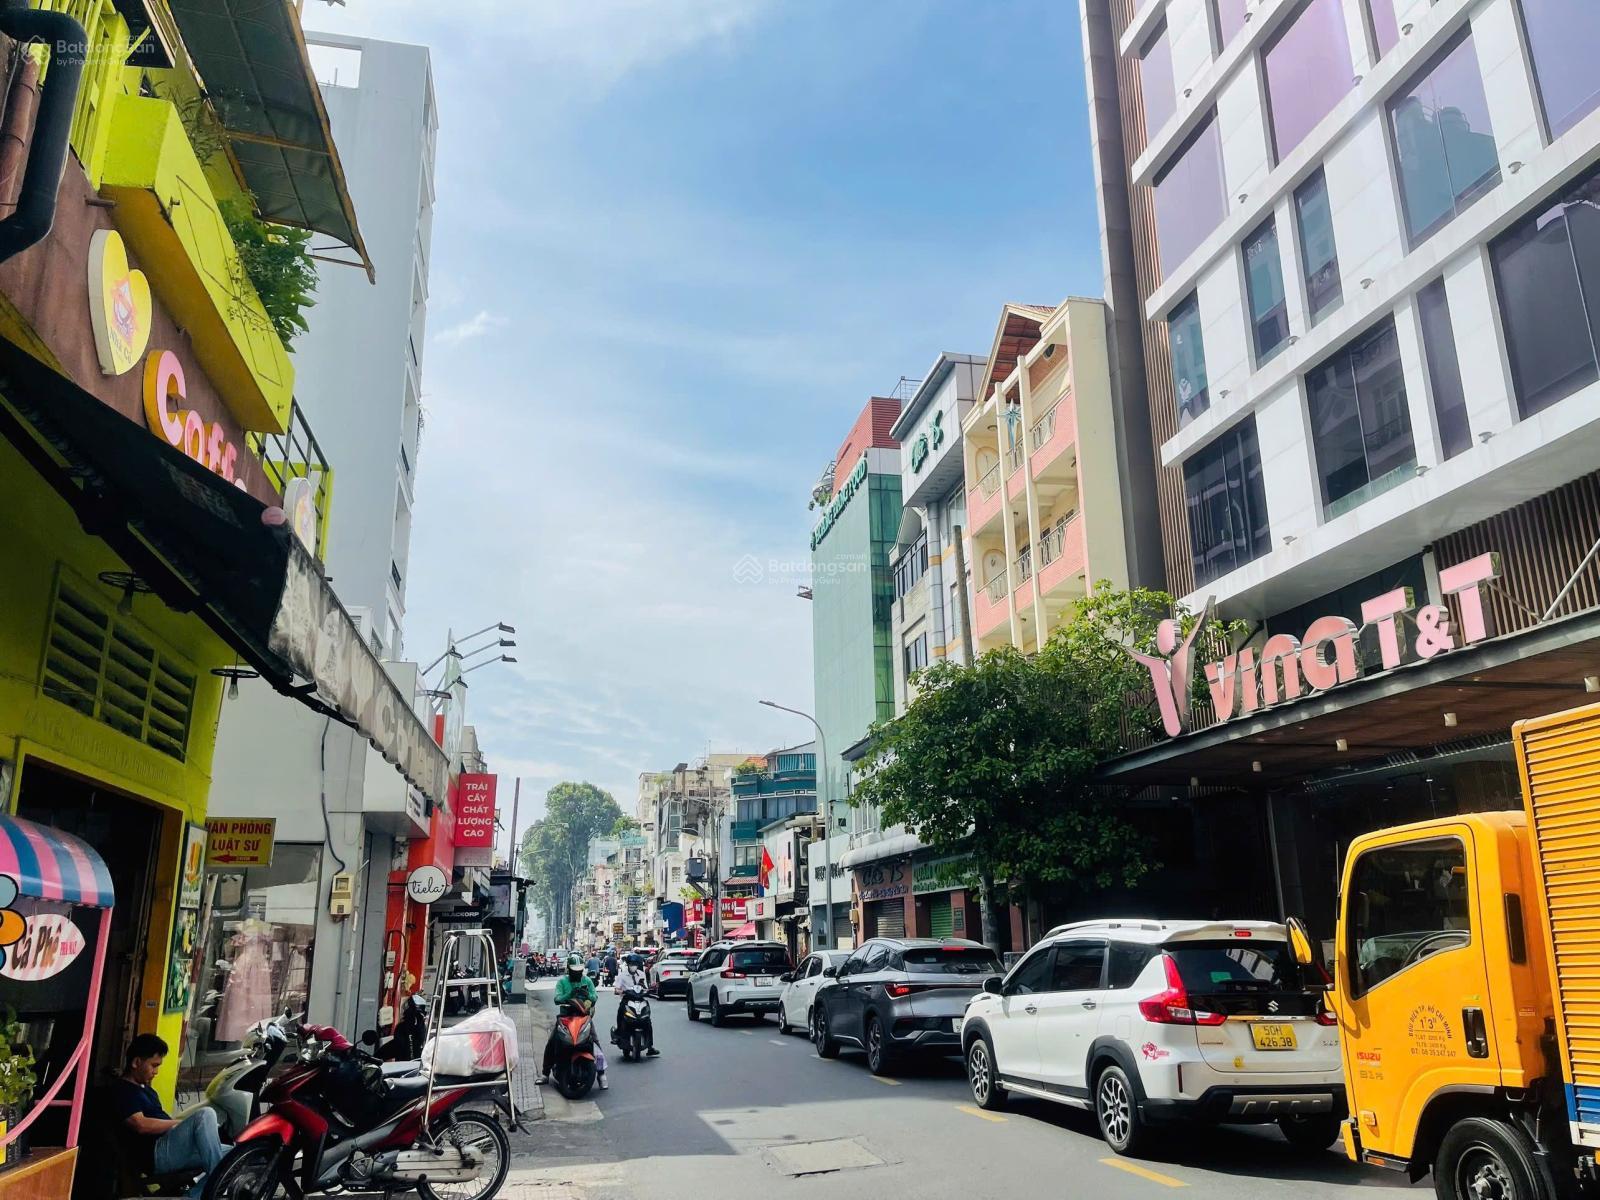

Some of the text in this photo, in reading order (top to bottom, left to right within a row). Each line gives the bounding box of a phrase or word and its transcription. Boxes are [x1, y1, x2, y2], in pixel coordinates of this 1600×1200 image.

[143, 350, 247, 494] Coff
[1360, 551, 1500, 671] T&T
[463, 829, 485, 837] CAO
[1259, 1036, 1294, 1048] 426.38
[1356, 1051, 1381, 1062] ISUZU
